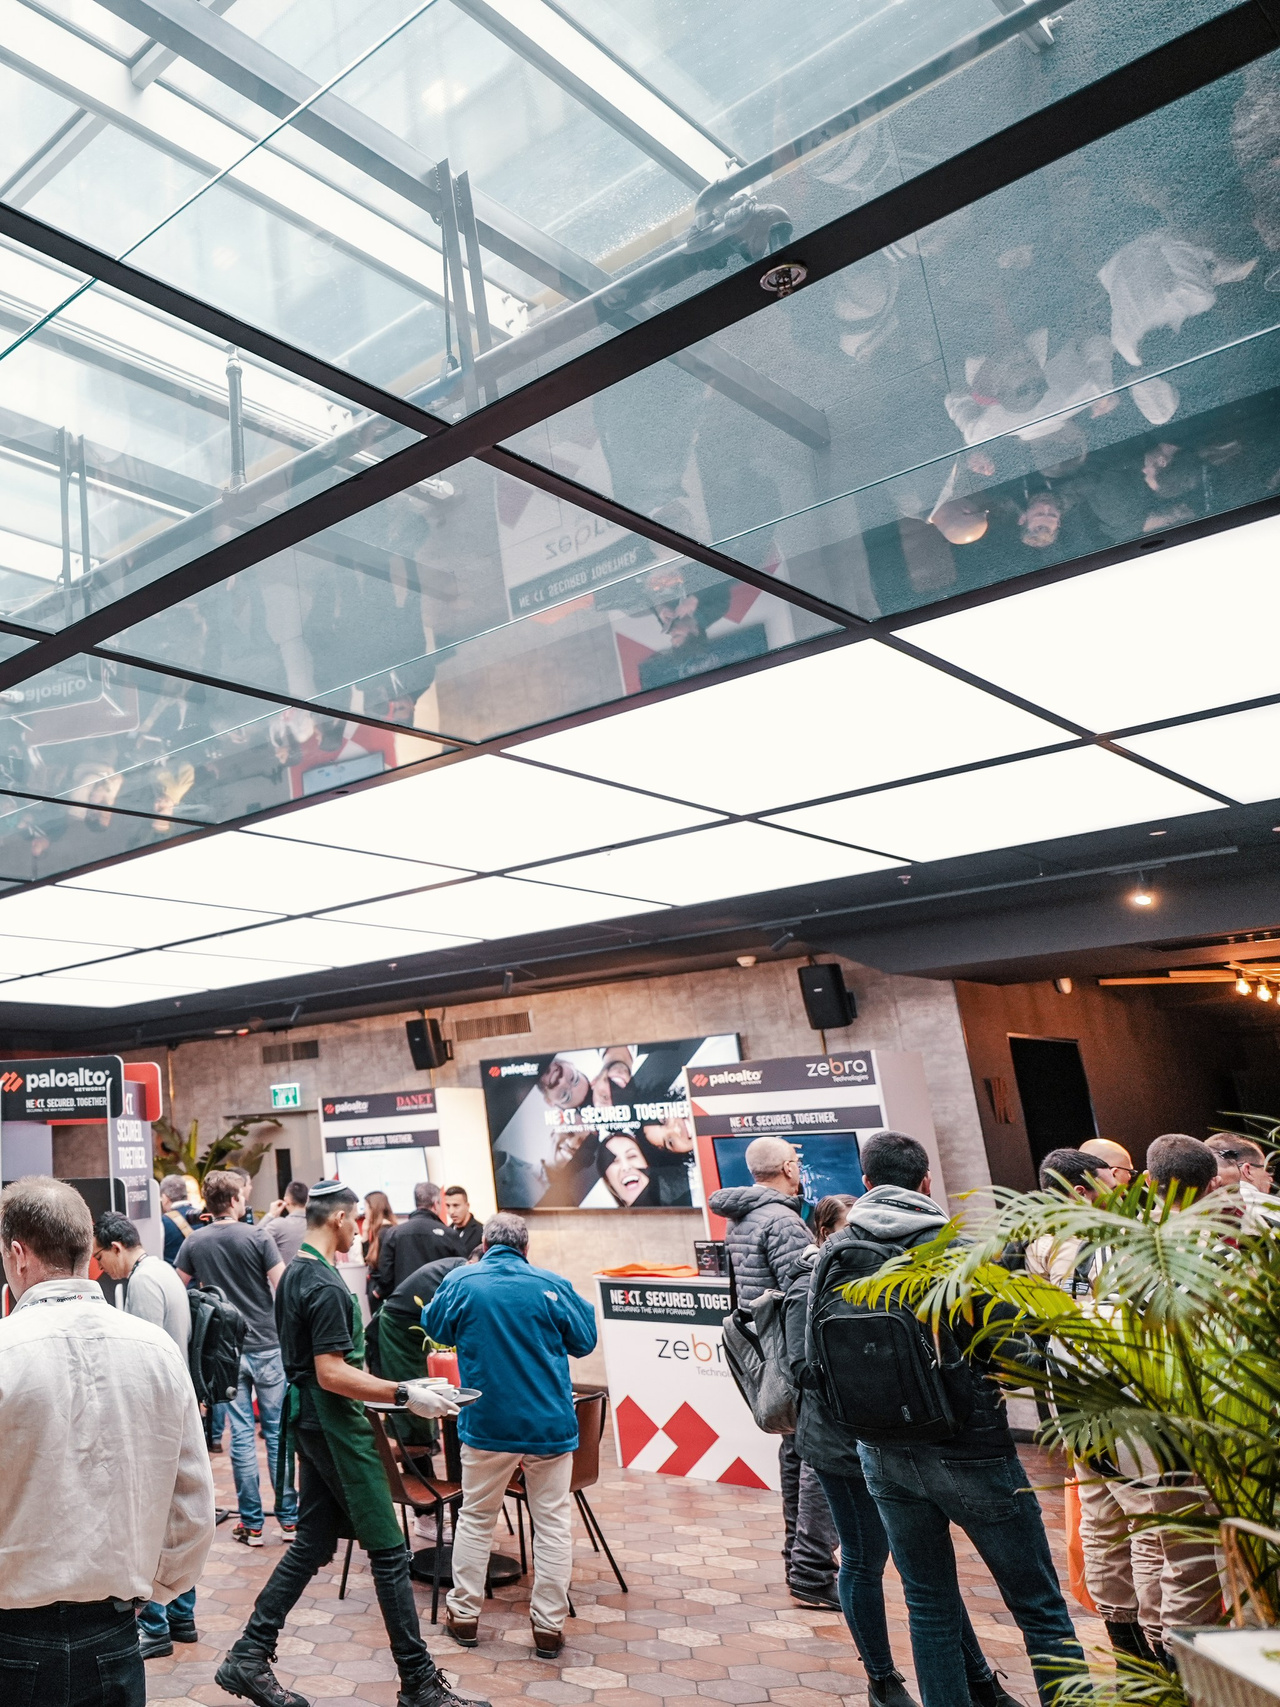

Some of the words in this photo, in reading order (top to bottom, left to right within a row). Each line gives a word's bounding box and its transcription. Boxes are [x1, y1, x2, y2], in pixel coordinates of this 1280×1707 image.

[501, 1062, 539, 1077] paloalto
[806, 1058, 868, 1077] zebra
[26, 1067, 107, 1092] paloalto
[709, 1069, 761, 1087] paloalto
[832, 1074, 869, 1083] Technologies
[46, 1097, 76, 1108] SECURED.
[335, 1100, 369, 1114] paloalto
[396, 1093, 432, 1107] DANET
[609, 1288, 644, 1306] NEXT.
[645, 1290, 698, 1309] SECURED.
[697, 1293, 731, 1311] TOGET
[612, 1305, 640, 1314] SECURING
[640, 1306, 653, 1314] THE
[652, 1307, 666, 1315] WAY
[666, 1308, 697, 1317] FORWARD
[655, 1333, 724, 1363] zebr
[696, 1366, 731, 1378] Technol
